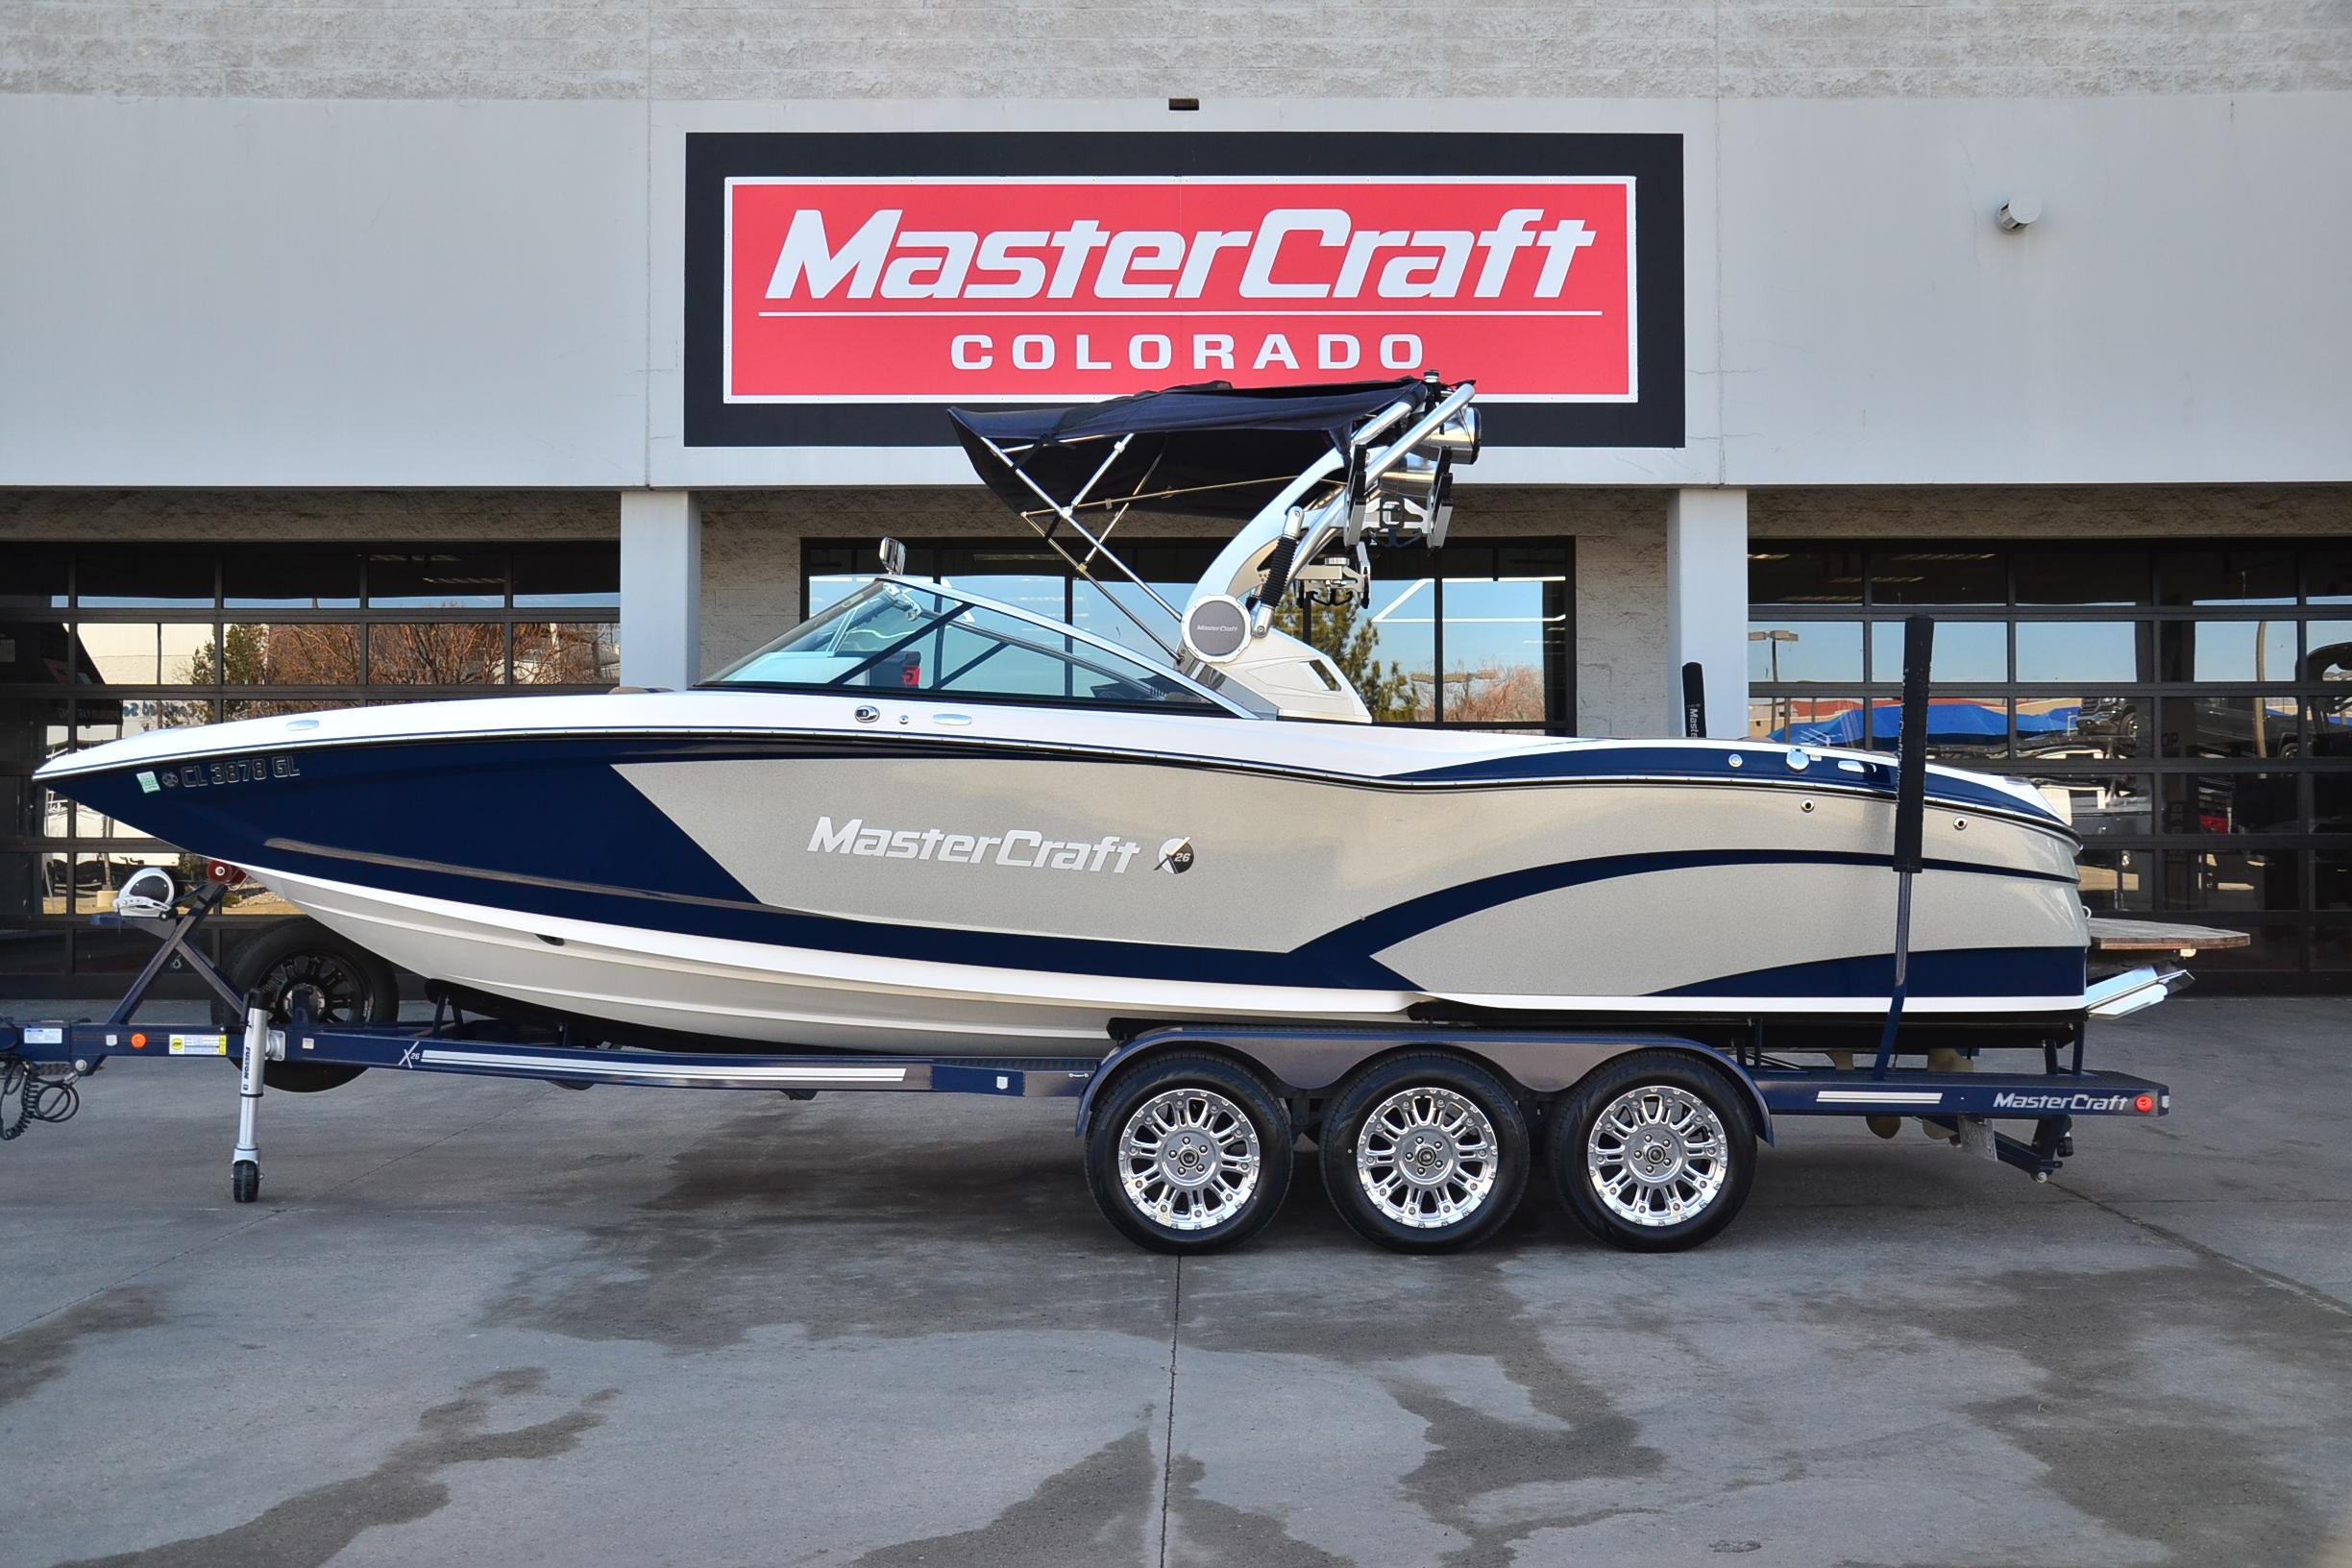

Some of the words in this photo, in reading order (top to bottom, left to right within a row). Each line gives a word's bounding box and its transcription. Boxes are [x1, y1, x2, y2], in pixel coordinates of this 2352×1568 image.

[766, 208, 1595, 300] MasterCraft
[950, 333, 1424, 371] COLORADO
[181, 765, 208, 787] CL
[807, 817, 1140, 873] MasterCraft
[1993, 1092, 2127, 1111] MasterCraft
